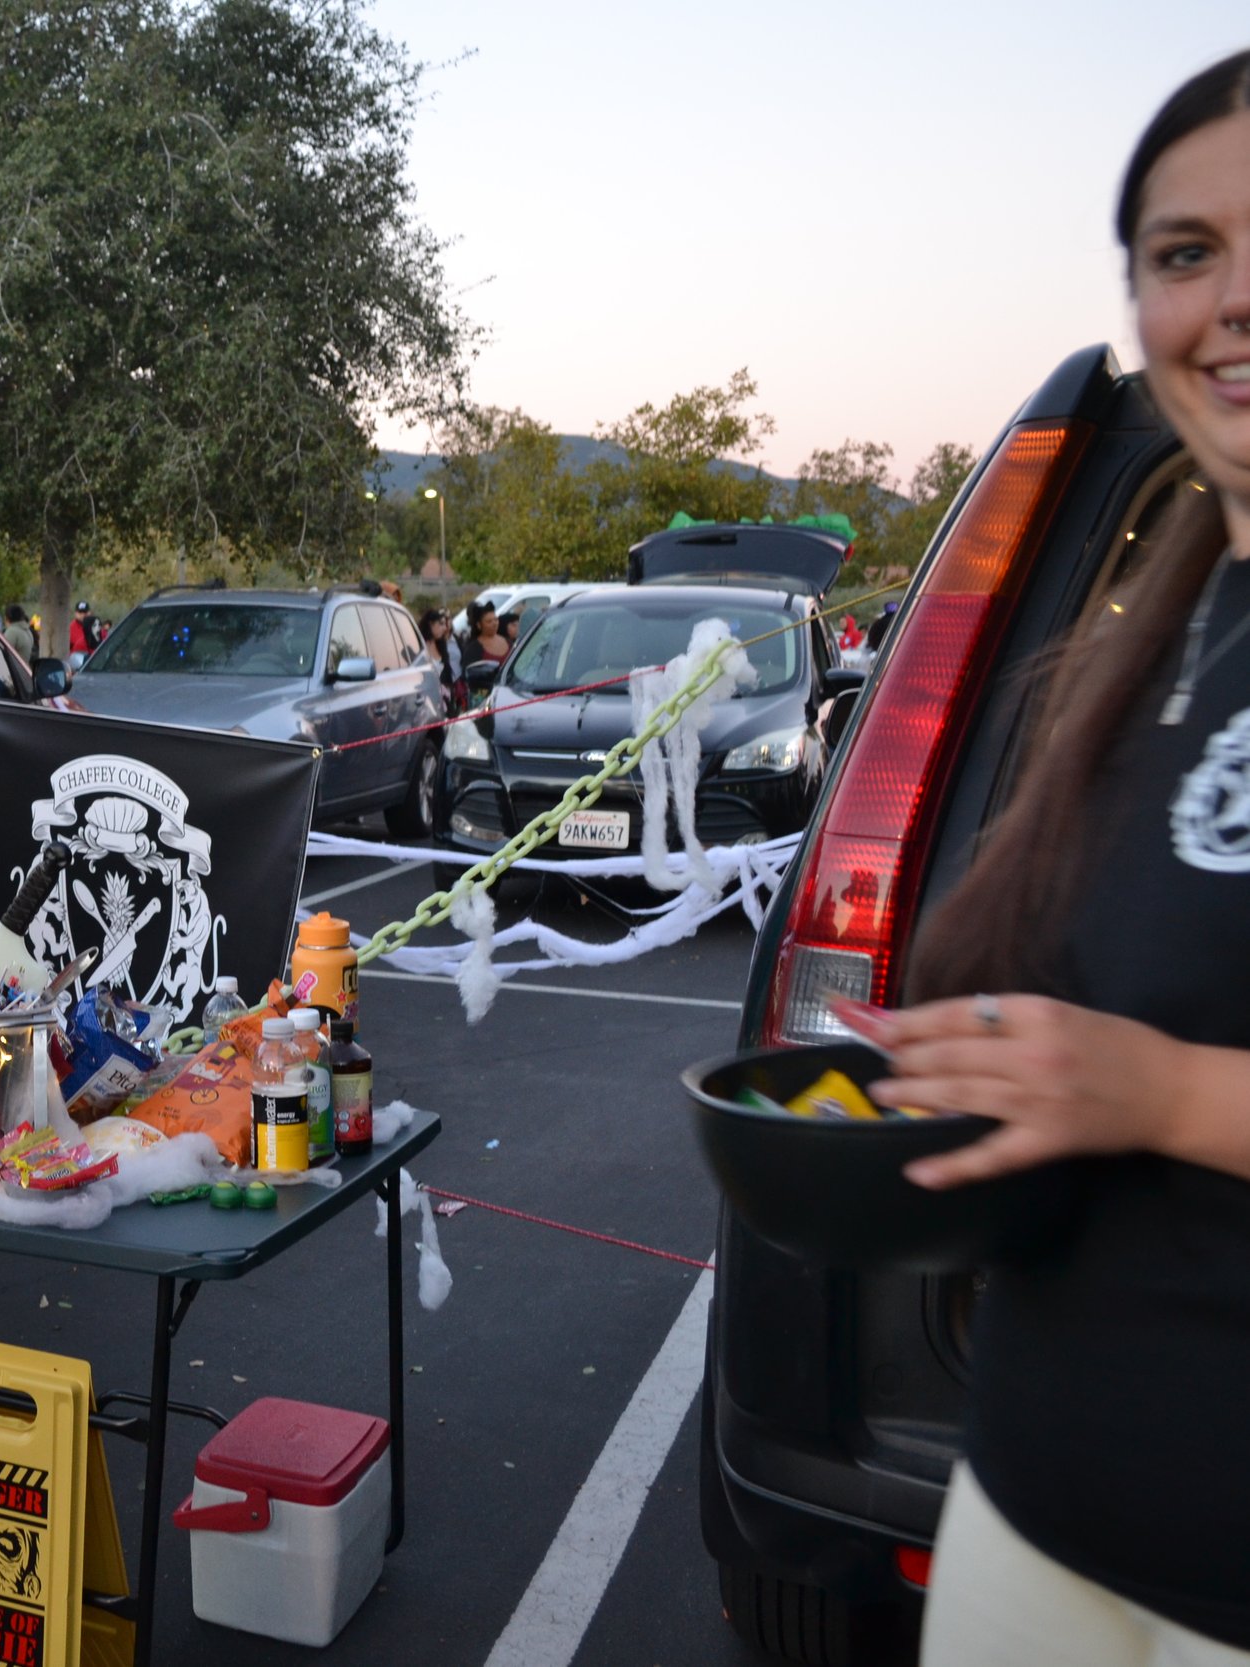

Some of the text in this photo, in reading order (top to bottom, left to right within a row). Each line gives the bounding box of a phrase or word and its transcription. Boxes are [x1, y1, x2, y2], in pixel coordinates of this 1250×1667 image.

[58, 766, 180, 814] CHAFFEY COLLEGE
[564, 823, 624, 842] 9AKW657
[277, 1111, 296, 1120] energy
[10, 1612, 40, 1636] OF
